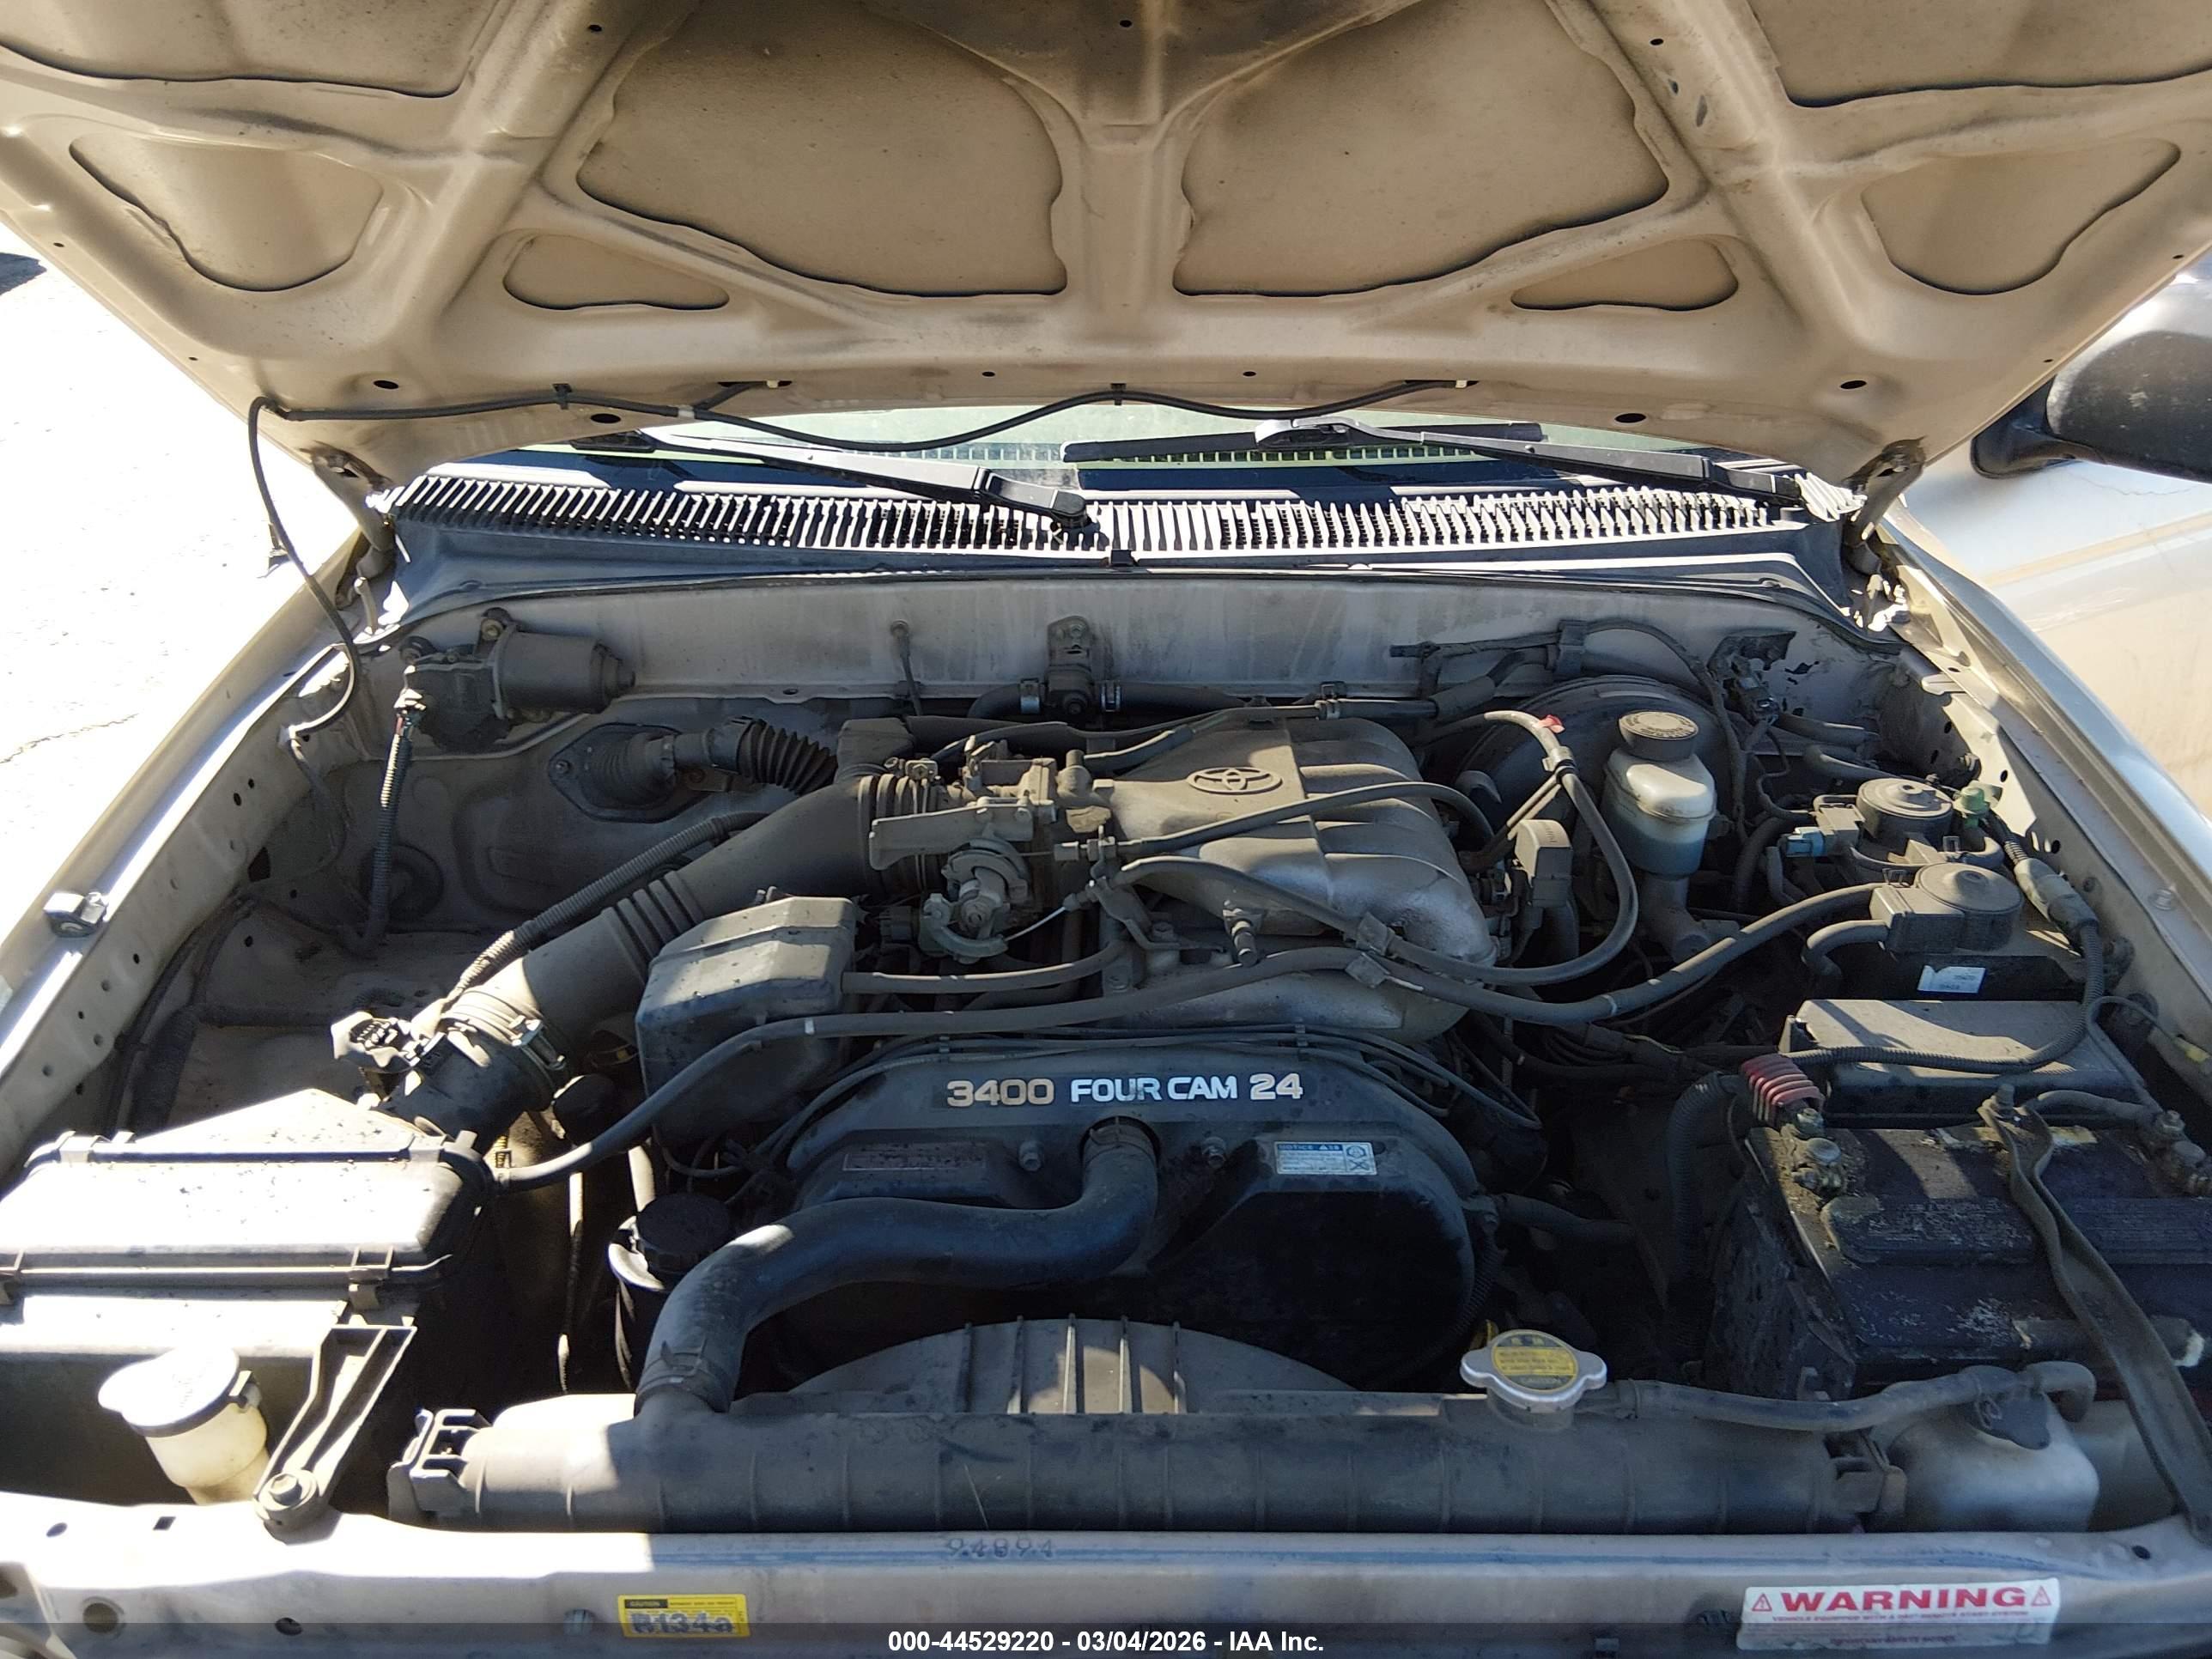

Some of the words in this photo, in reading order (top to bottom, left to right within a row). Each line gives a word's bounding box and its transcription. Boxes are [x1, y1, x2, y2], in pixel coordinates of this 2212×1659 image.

[946, 1079, 1054, 1106] 3400
[1070, 1078, 1162, 1102] FOUR
[1168, 1076, 1237, 1099] CAM
[1249, 1073, 1304, 1100] 24
[1780, 1587, 2027, 1612] WARNING
